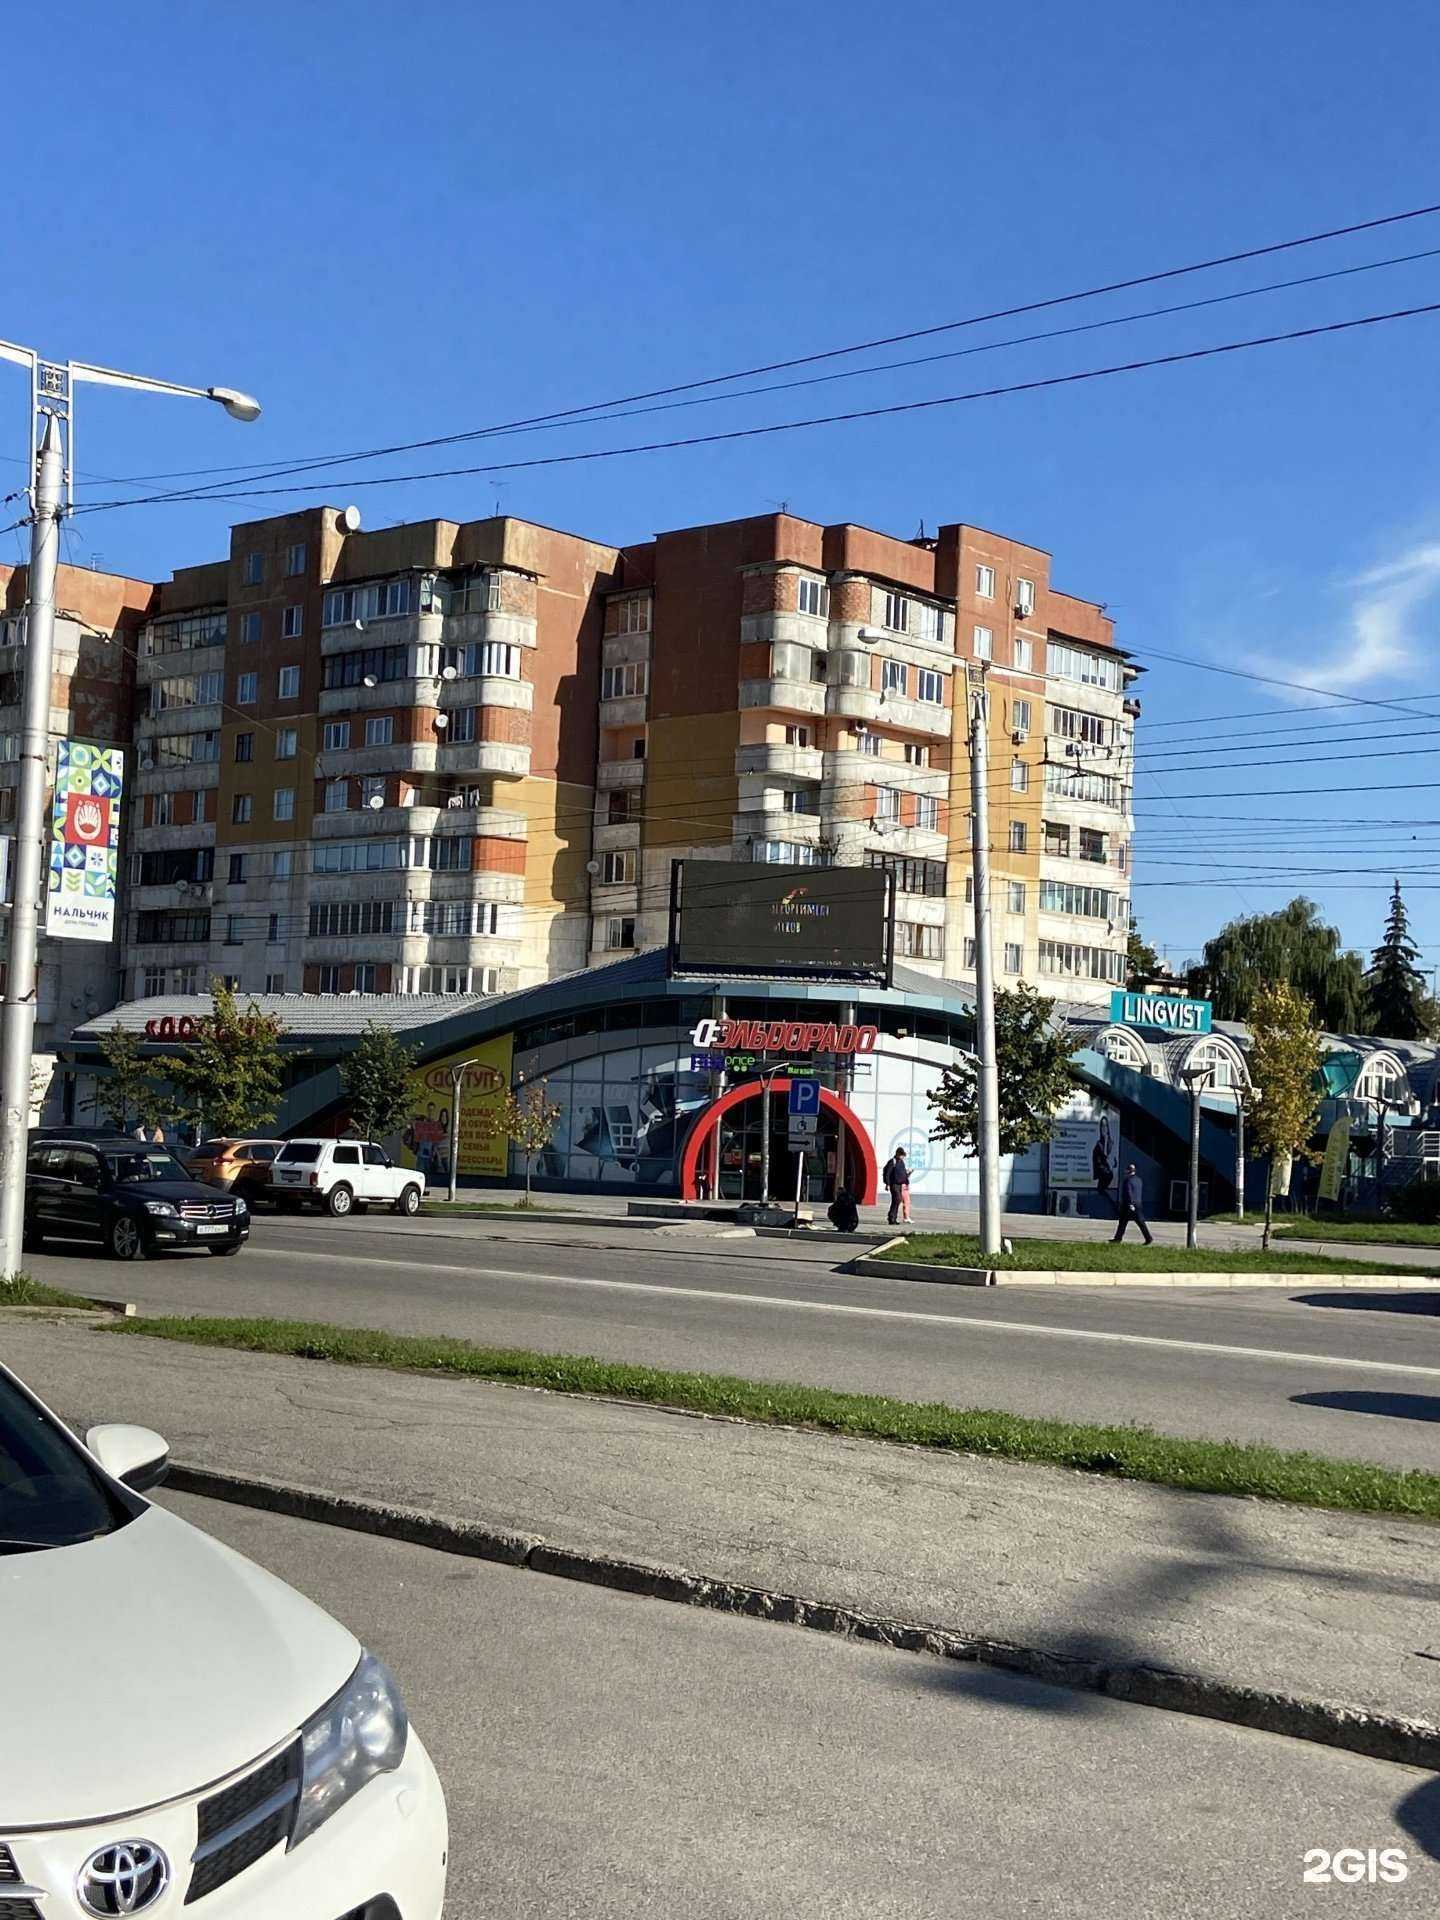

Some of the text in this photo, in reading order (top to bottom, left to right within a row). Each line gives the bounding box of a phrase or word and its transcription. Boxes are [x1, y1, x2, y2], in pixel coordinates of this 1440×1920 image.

[54, 906, 109, 920] НАЛЬЧИК
[1124, 995, 1205, 1030] LINGVIST
[725, 1055, 756, 1069] price
